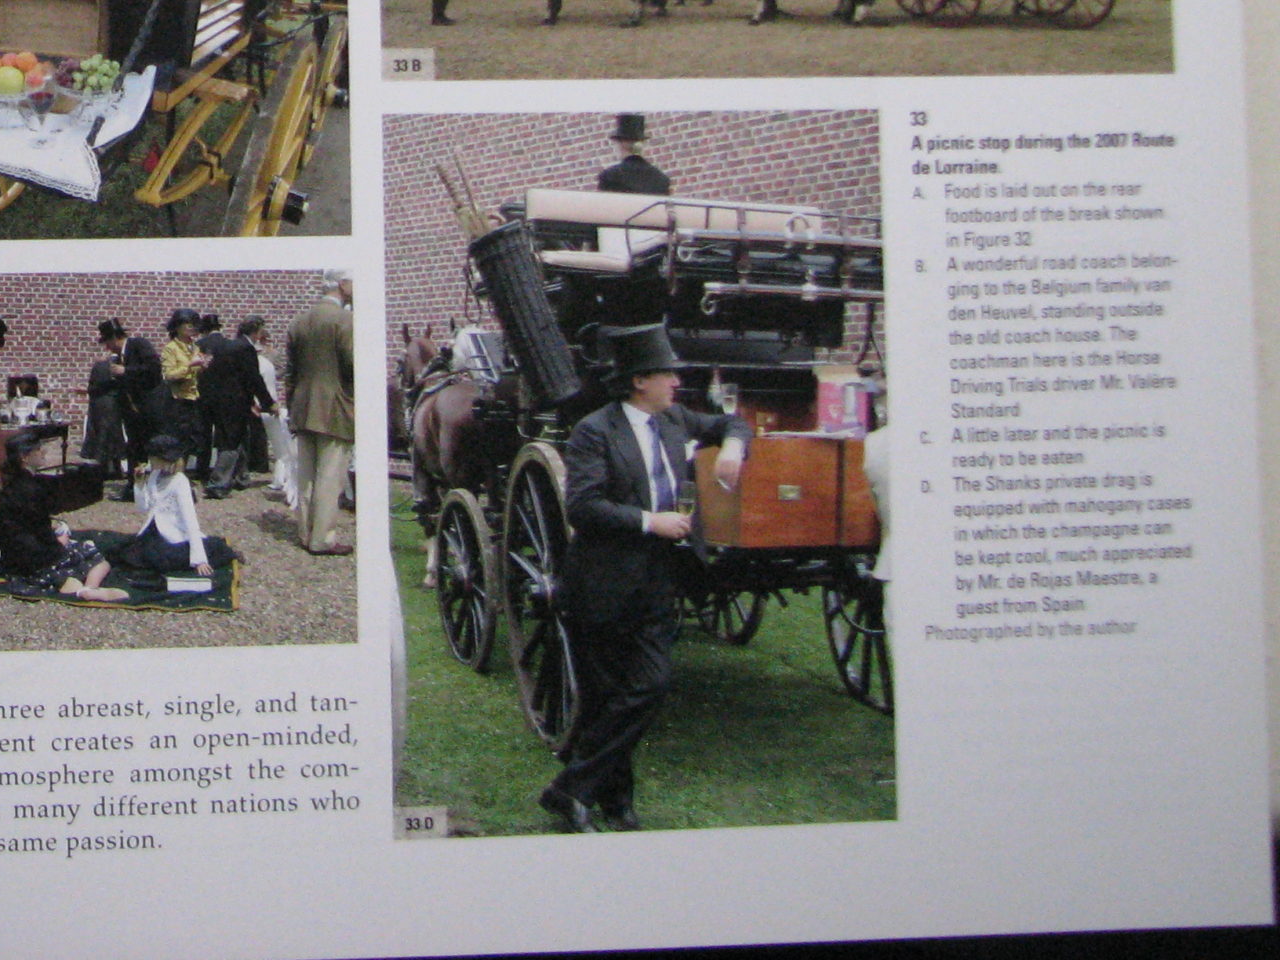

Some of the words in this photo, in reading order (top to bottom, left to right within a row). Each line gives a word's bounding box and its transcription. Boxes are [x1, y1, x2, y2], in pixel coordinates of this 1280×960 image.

[393, 60, 408, 72] 33
[412, 59, 421, 71] B
[910, 112, 927, 126] 33
[912, 136, 921, 150] A
[927, 135, 974, 153] picnic
[979, 135, 1010, 152] stop
[1015, 134, 1063, 152] during
[1068, 134, 1091, 148] the
[912, 161, 930, 175] de
[945, 184, 980, 198] Food
[947, 257, 958, 271] A
[952, 429, 963, 442] A
[58, 695, 151, 721] abreast,
[163, 693, 241, 721] single,
[254, 692, 296, 714] and
[310, 691, 357, 713] tan-
[51, 728, 134, 751] creates
[149, 731, 178, 748] an
[193, 724, 357, 753] open-minded,
[129, 761, 232, 788] amongst
[248, 760, 285, 780] the
[300, 761, 359, 778] com-
[14, 799, 80, 823] many
[93, 794, 197, 816] different
[210, 792, 298, 813] nations
[311, 790, 360, 811] who
[406, 818, 420, 830] 33
[65, 828, 162, 856] passion.
